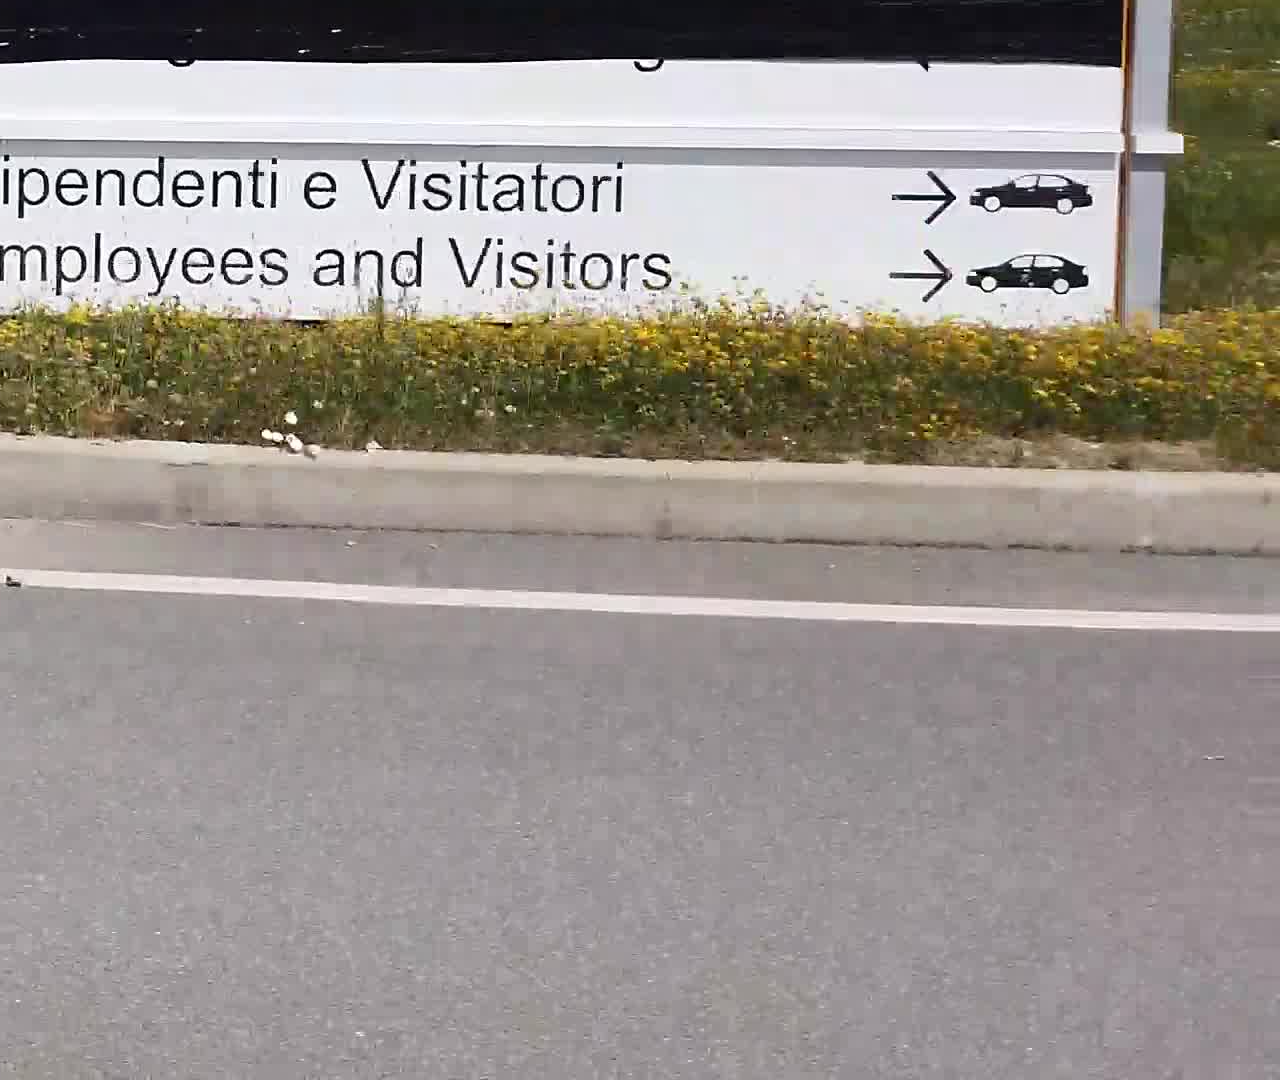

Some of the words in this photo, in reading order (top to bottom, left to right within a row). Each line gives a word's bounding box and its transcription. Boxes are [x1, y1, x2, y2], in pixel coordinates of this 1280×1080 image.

[303, 171, 337, 210] e
[360, 158, 624, 213] Visitatori
[313, 236, 423, 289] and
[448, 237, 673, 291] Visitors
